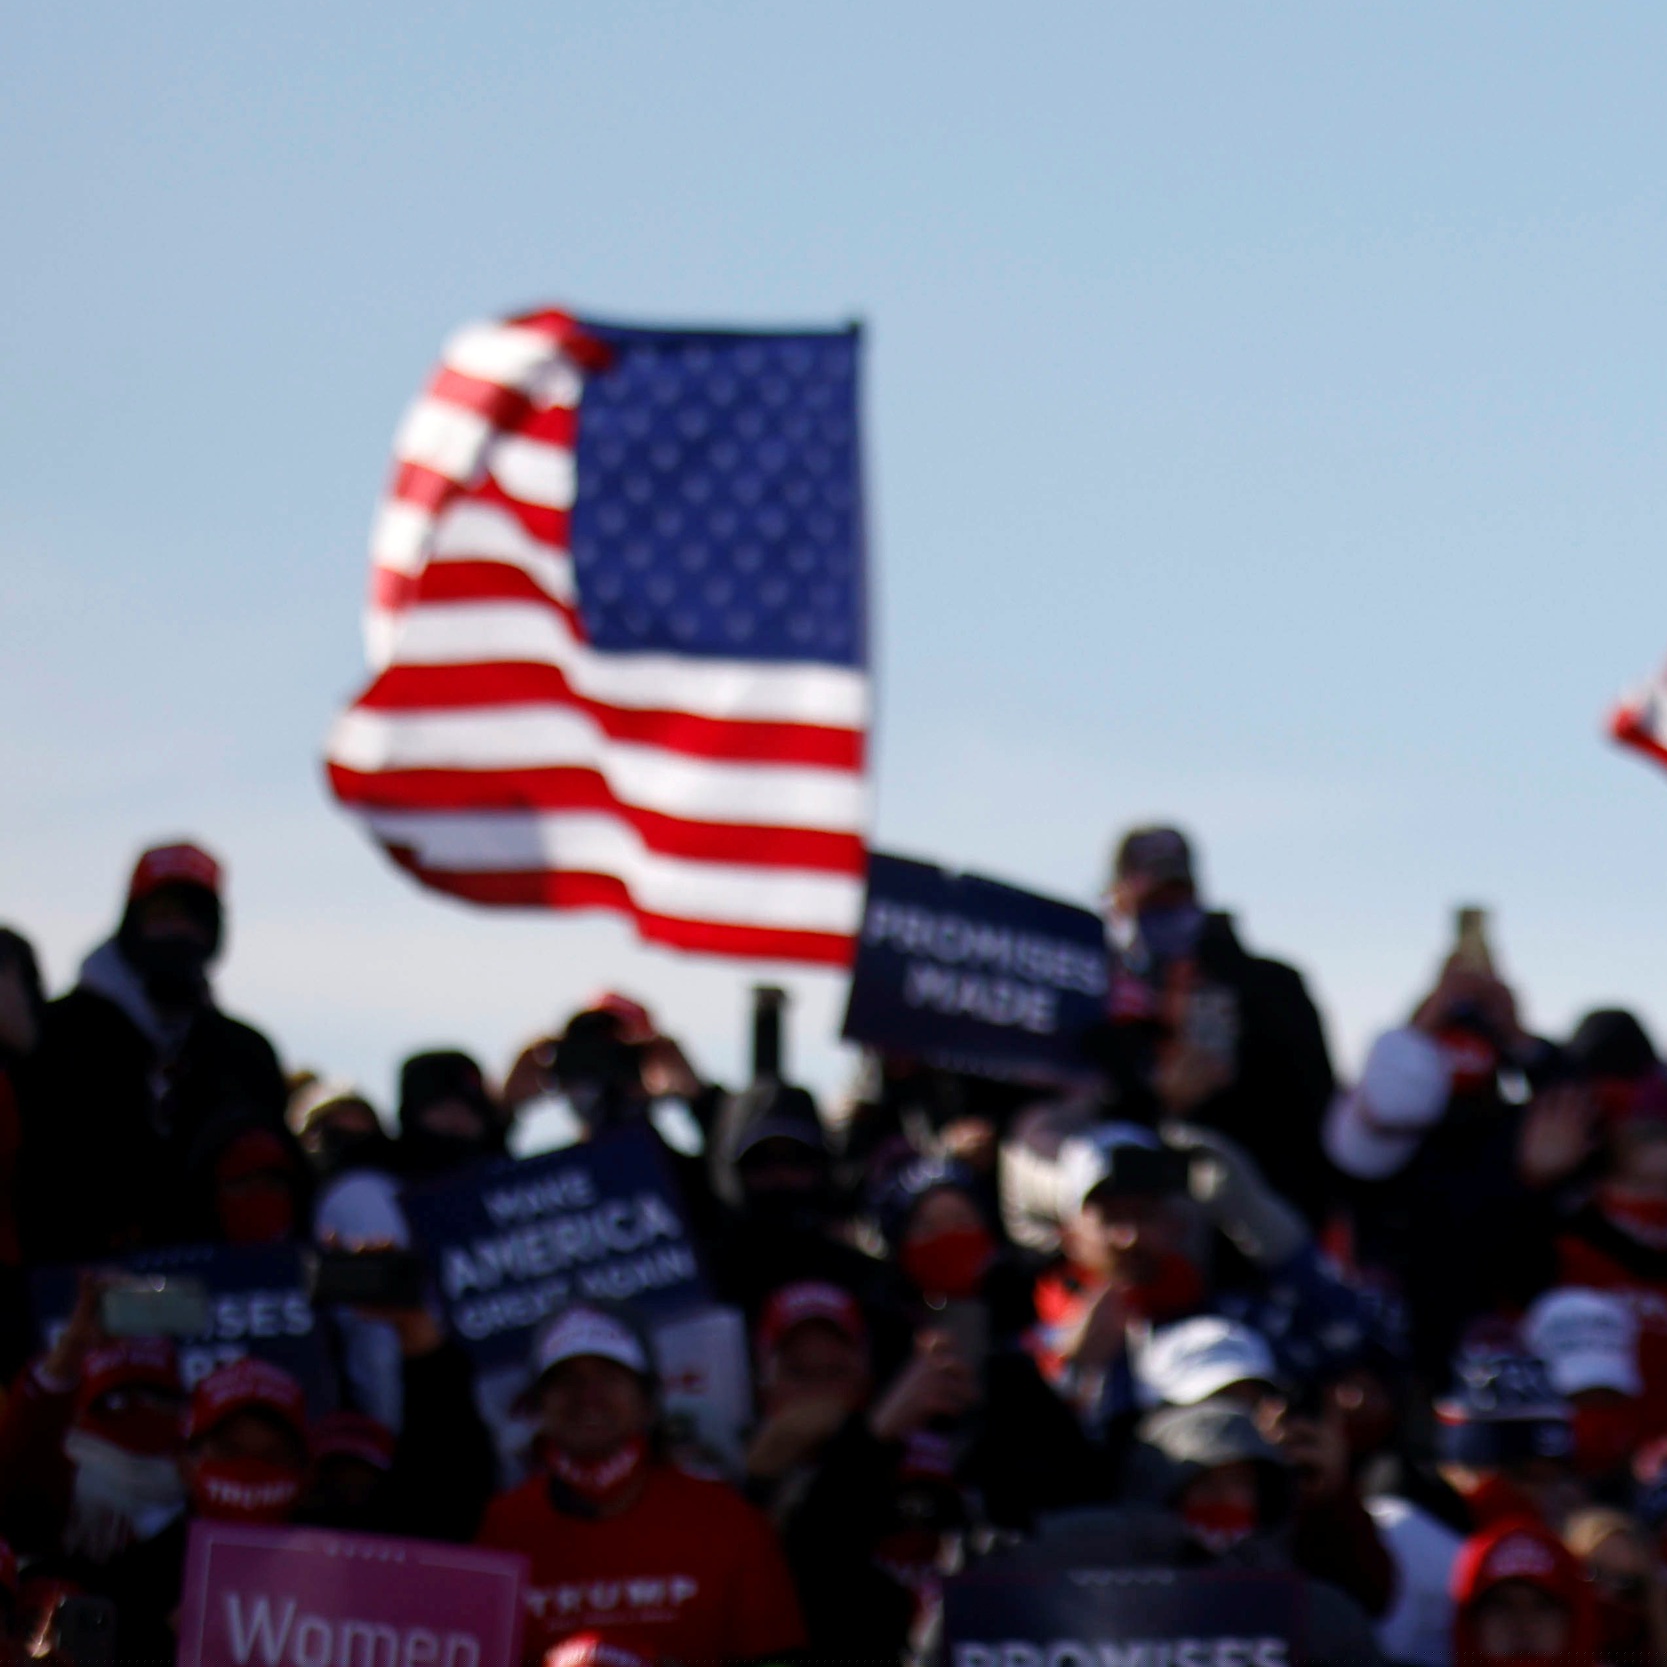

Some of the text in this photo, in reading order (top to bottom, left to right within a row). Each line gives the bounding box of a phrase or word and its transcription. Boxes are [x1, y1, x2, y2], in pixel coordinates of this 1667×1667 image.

[864, 898, 1108, 998] PROMISES
[904, 962, 1062, 1035] MADE
[483, 1169, 597, 1226] MAKE
[442, 1193, 683, 1300] AMERICA
[454, 1276, 571, 1340] GREAT
[226, 1591, 483, 1667] Women
[525, 1573, 698, 1619] TRUMP
